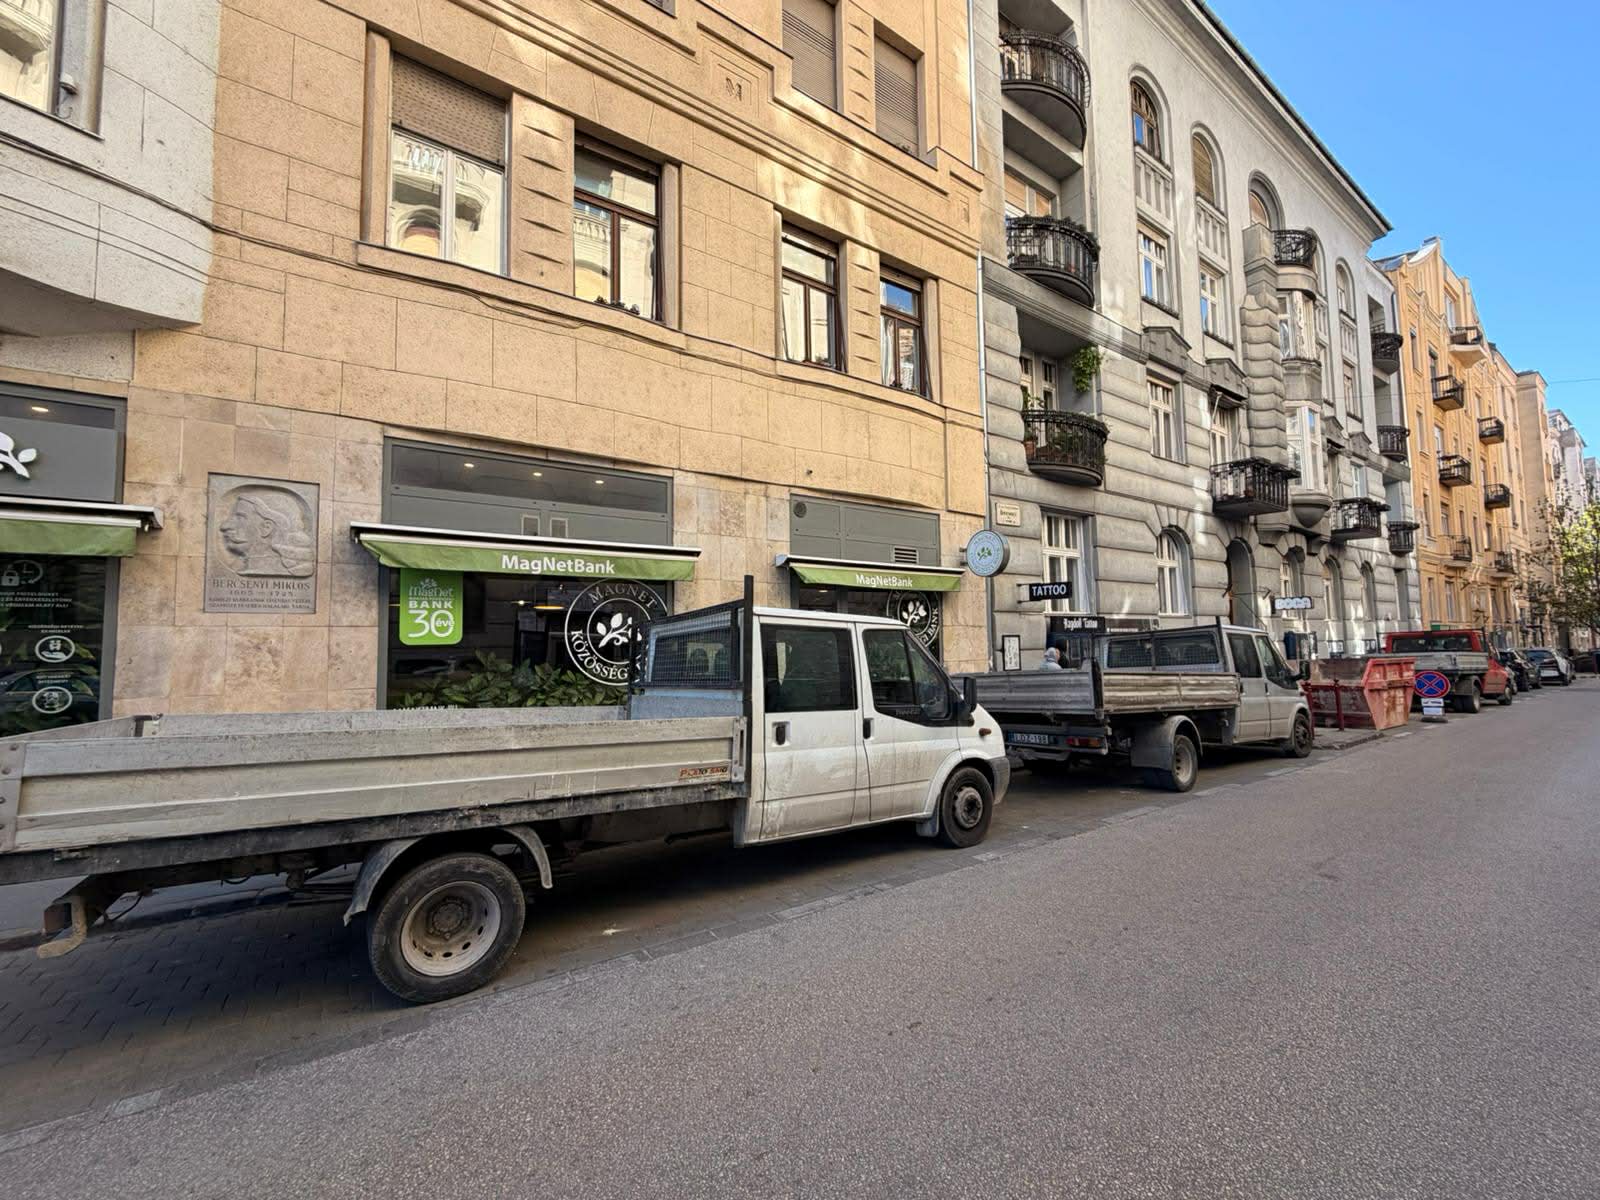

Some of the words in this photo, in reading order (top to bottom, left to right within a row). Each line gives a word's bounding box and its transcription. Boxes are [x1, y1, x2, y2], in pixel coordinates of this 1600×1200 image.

[501, 554, 615, 575] MagNetBank
[855, 573, 913, 588] MagNetBank
[1031, 584, 1067, 597] TATTOO
[408, 600, 453, 609] BANK
[588, 583, 658, 609] MAGNET
[407, 609, 455, 638] 30
[570, 628, 634, 681] KÖZÖSSÉG
